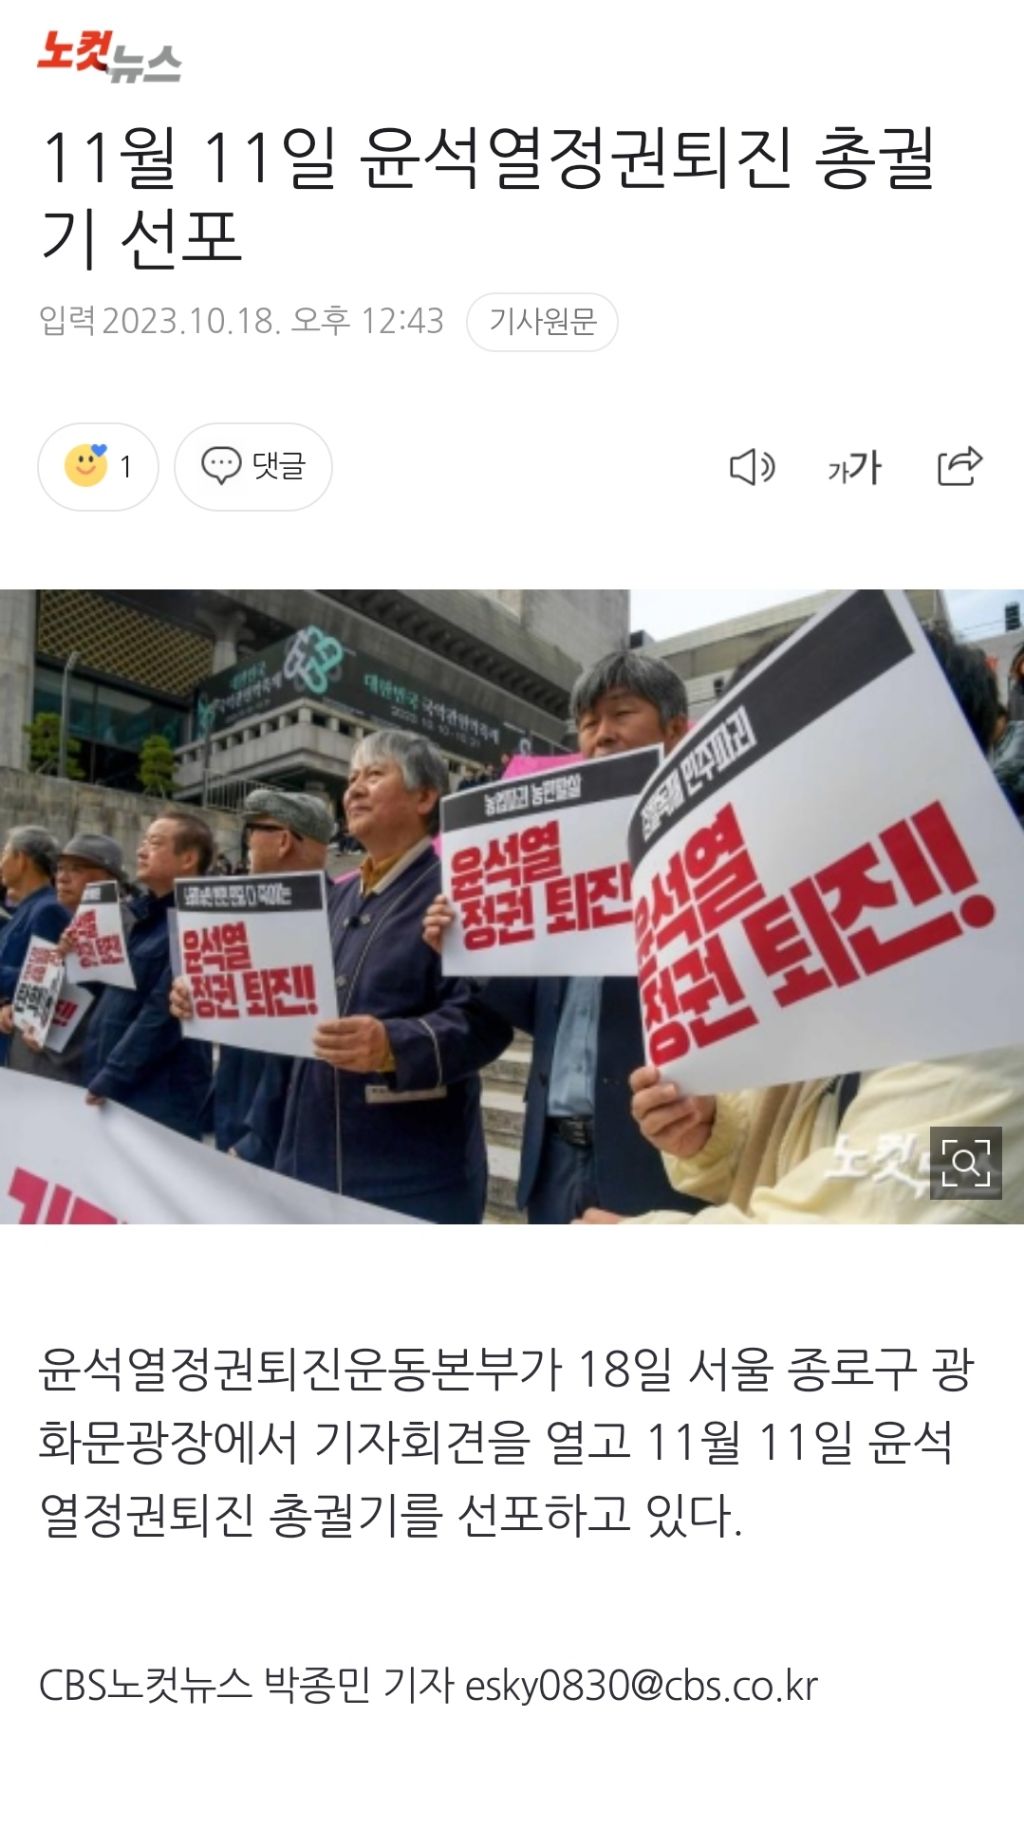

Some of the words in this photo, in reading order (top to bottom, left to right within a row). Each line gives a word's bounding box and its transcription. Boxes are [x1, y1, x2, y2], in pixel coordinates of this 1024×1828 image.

[37, 30, 182, 83] 노컷뉴스
[46, 126, 174, 190] 11월
[207, 126, 334, 190] 11일
[359, 126, 791, 190] 윤석열정권퇴진
[815, 126, 934, 190] 총궐
[43, 208, 93, 271] 기
[120, 208, 243, 271] 선포
[40, 305, 95, 337] 입력
[102, 307, 281, 335] 2023.10.18.
[291, 305, 351, 337] 오후
[362, 307, 443, 334] 12:43
[490, 307, 598, 336] 기사원문
[121, 455, 129, 479] 1
[253, 451, 306, 481] 댓글
[679, 705, 758, 797] 민주파괴
[451, 820, 563, 902] 윤석열
[461, 886, 536, 951] 정권
[633, 802, 767, 990] 윤석열
[183, 920, 252, 975] 윤석열
[641, 933, 760, 1067] 정권
[741, 799, 997, 1008] 퇴진!
[190, 973, 240, 1019] 정권
[242, 963, 318, 1018] 퇴진!
[38, 1347, 563, 1393] 윤석열정권퇴진운동본부가
[580, 1347, 671, 1393] 18일
[688, 1347, 775, 1393] 서울
[787, 1348, 918, 1393] 종로구
[931, 1347, 976, 1393] 광
[38, 1420, 297, 1466] 화문광장에서
[316, 1420, 531, 1466] 기자회견을
[547, 1420, 631, 1466] 열고
[649, 1420, 740, 1466] 11월
[761, 1420, 852, 1466] 11일
[868, 1420, 952, 1466] 윤석
[41, 1493, 253, 1539] 열정권퇴진
[269, 1493, 444, 1539] 총궐기를
[457, 1493, 631, 1539] 선포하고
[646, 1493, 742, 1539] 있다.
[39, 1666, 254, 1705] CBS노컷뉴스
[265, 1665, 370, 1705] 박종민
[384, 1666, 456, 1705] 기자
[465, 1666, 819, 1707] esky0830@cbs.co.kr
